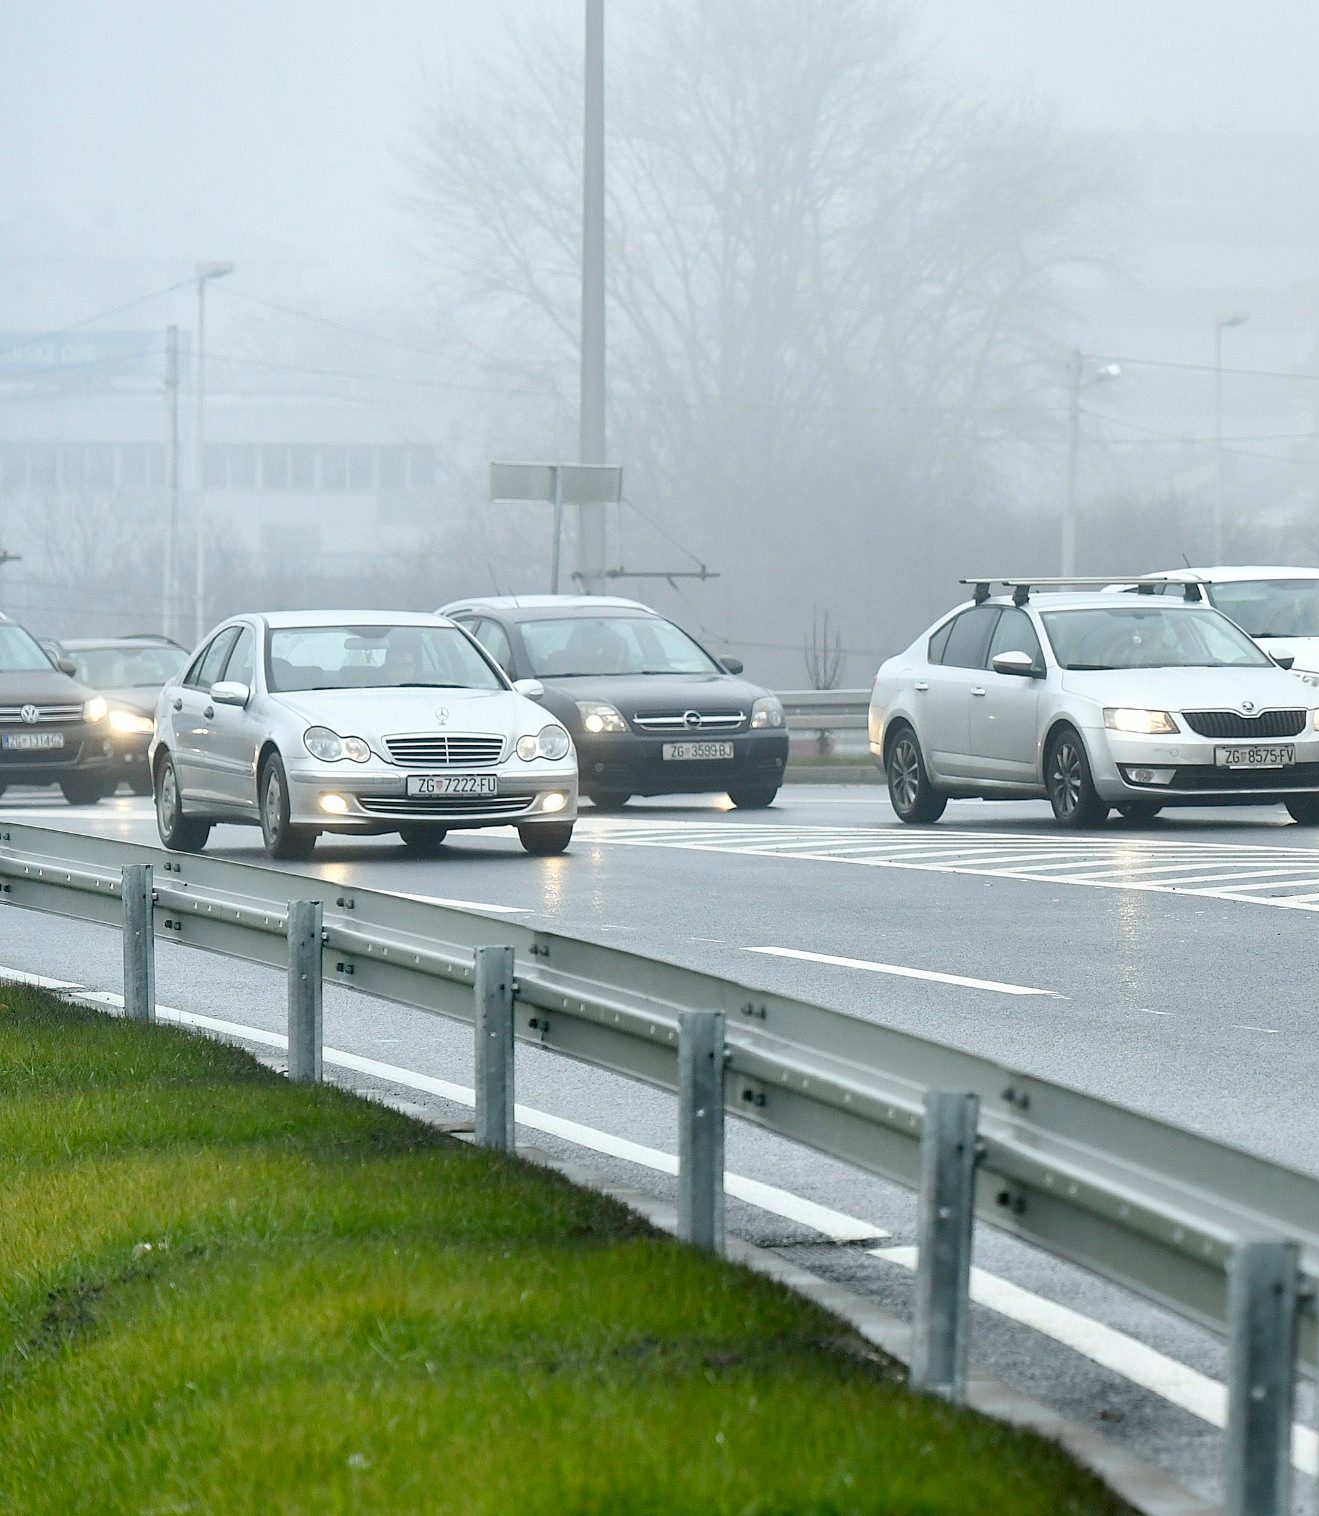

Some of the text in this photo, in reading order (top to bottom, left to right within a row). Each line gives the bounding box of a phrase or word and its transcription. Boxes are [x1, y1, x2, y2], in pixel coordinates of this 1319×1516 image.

[671, 745, 684, 758] ZG
[1225, 750, 1240, 764] ZG
[418, 778, 435, 793] ZG
